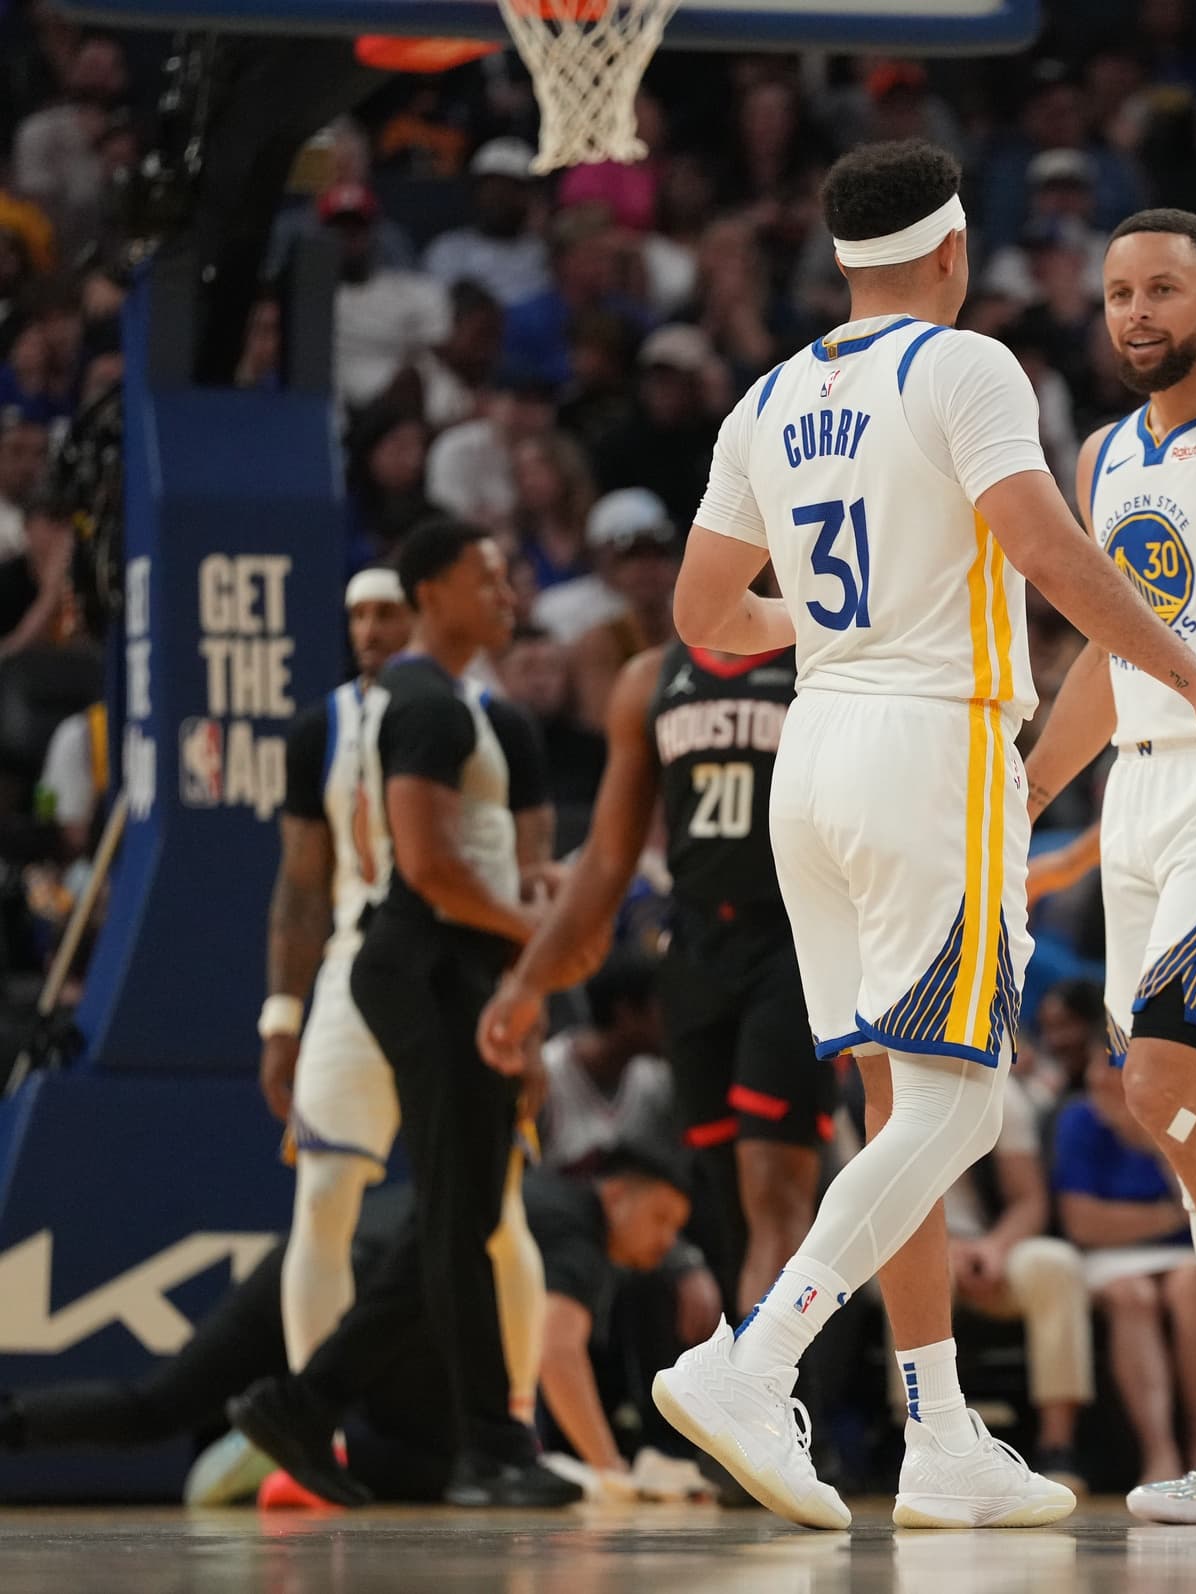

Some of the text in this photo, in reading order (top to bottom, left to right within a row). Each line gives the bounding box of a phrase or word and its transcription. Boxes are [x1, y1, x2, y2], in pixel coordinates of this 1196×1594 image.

[782, 408, 872, 469] CURRY
[1100, 493, 1191, 543] GOLDEN STATE
[200, 552, 293, 635] GET
[791, 496, 872, 631] 31
[1143, 539, 1180, 580] 30
[200, 637, 297, 718] THE
[225, 720, 288, 822] Ap
[688, 762, 755, 839] 20
